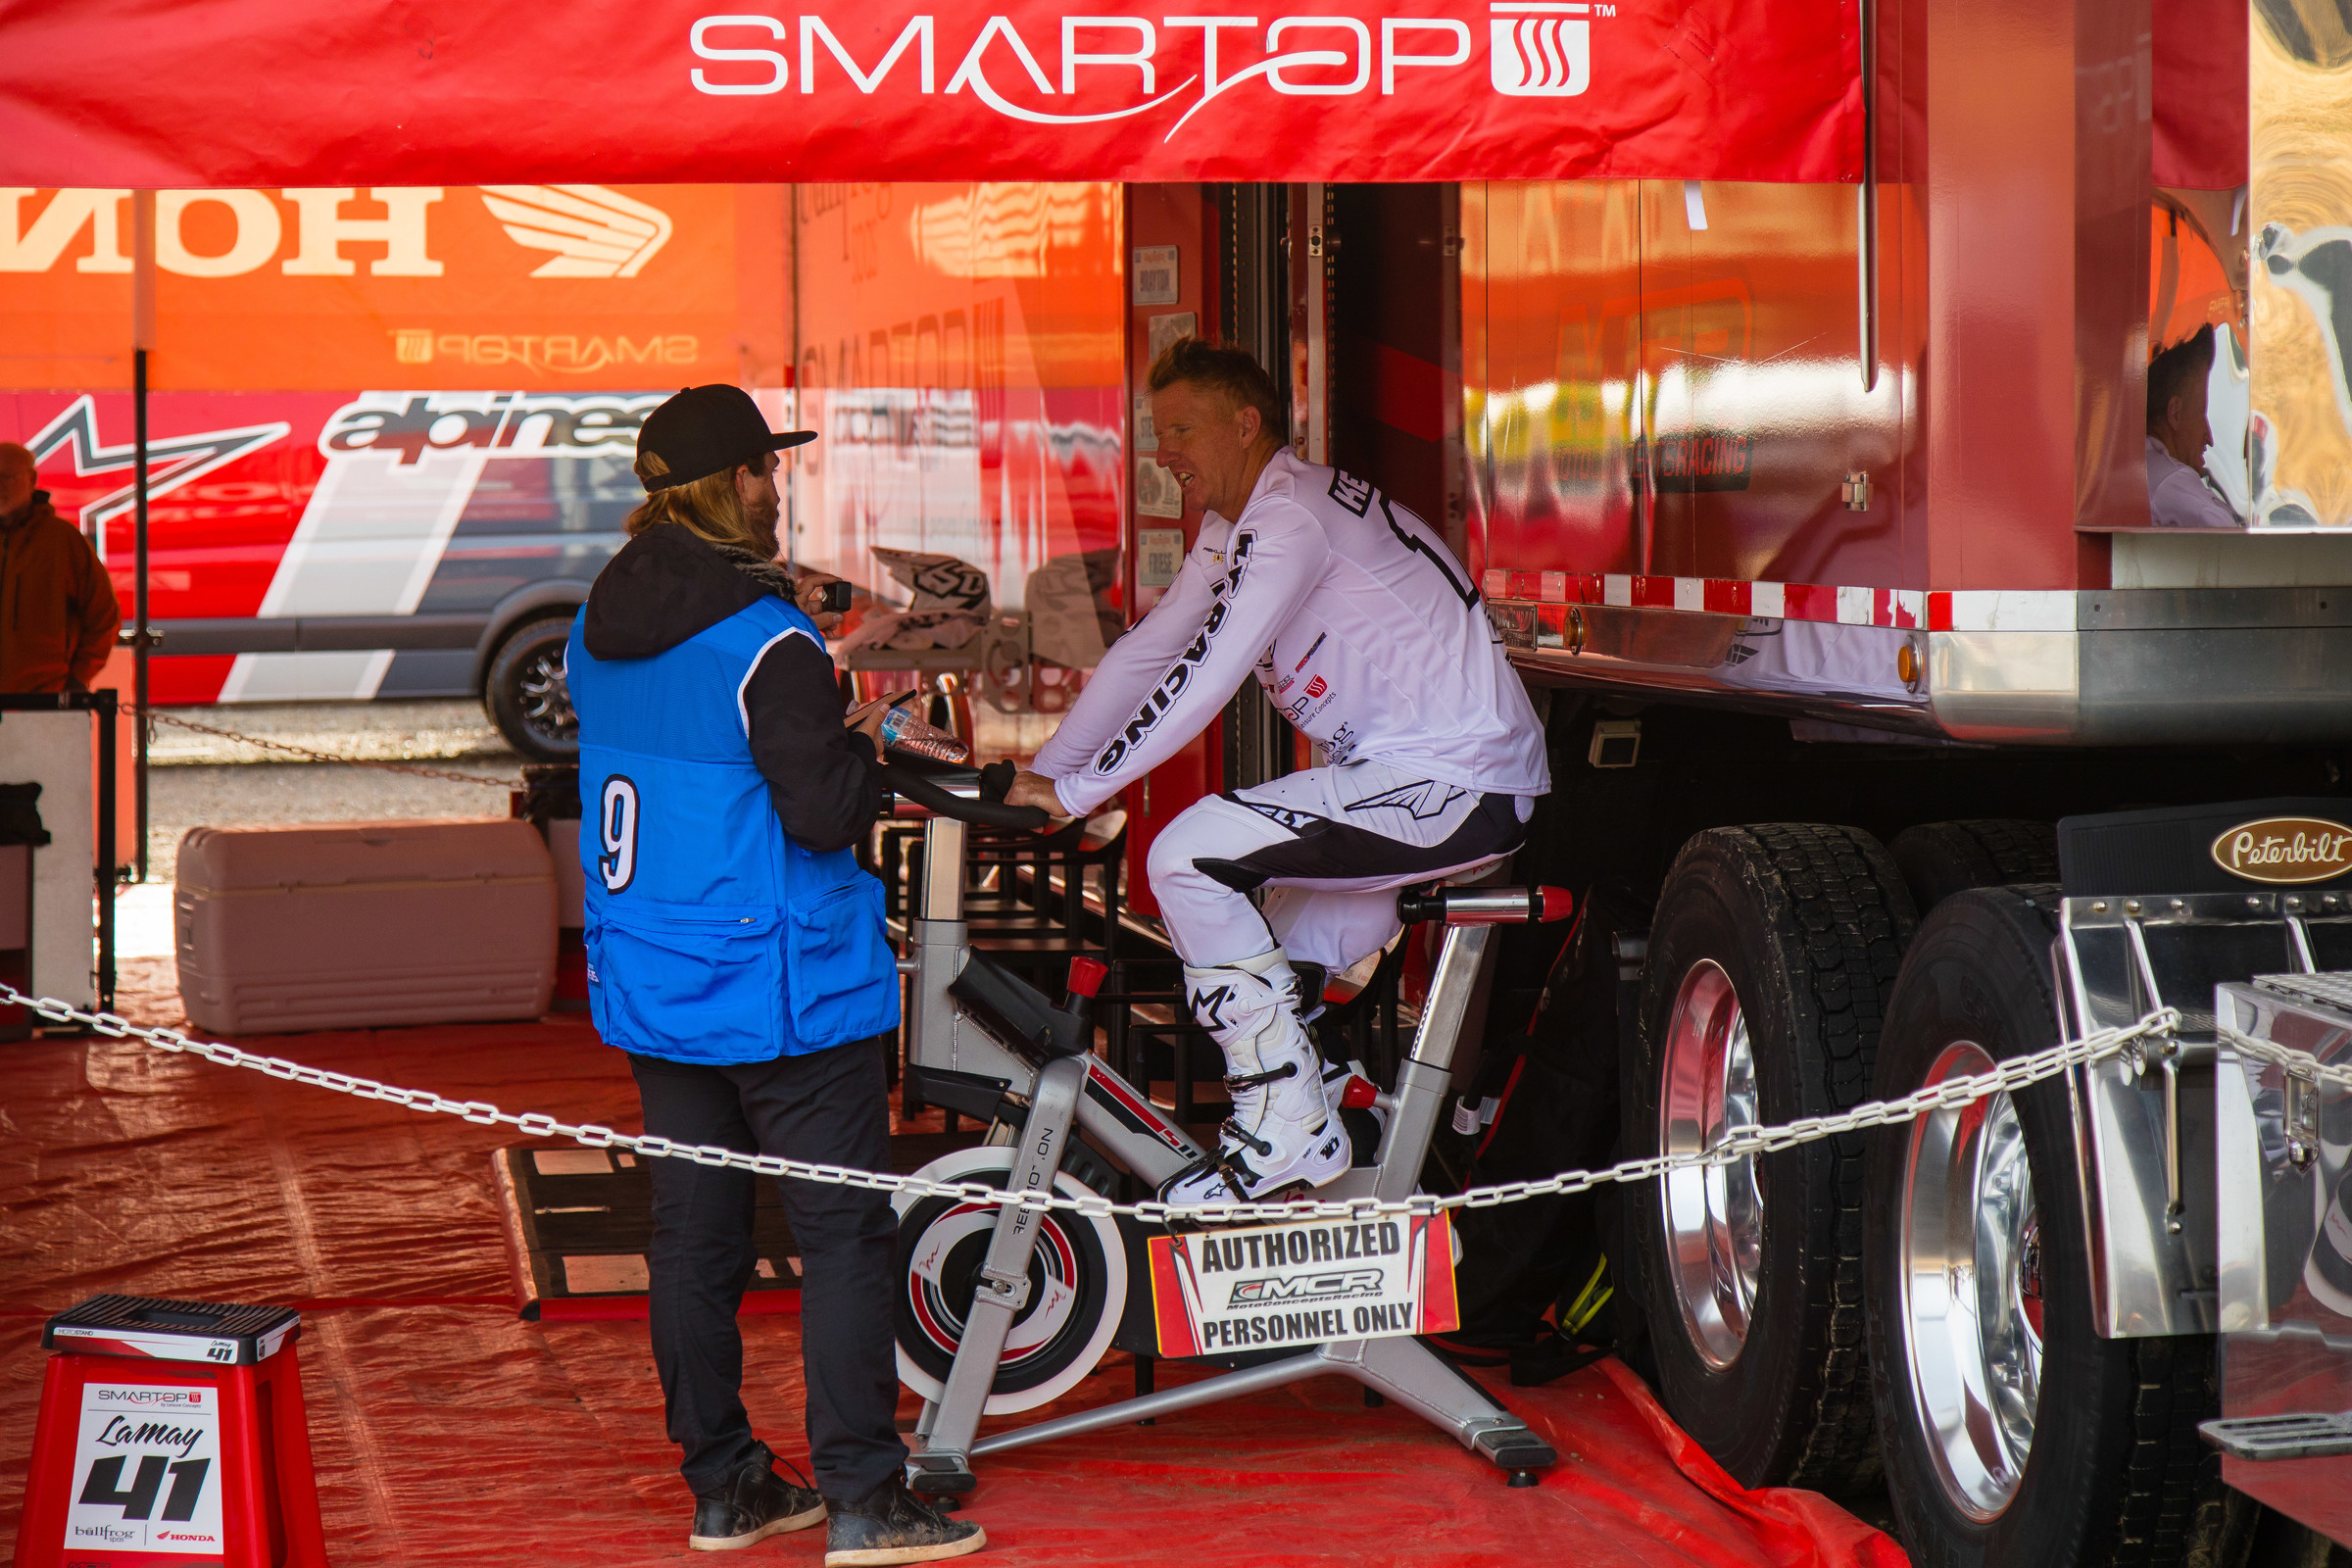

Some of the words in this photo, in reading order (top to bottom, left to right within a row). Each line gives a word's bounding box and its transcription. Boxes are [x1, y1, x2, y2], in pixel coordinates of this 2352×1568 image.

[690, 15, 1470, 143] SMARTOP
[1095, 599, 1230, 775] RACING
[599, 773, 641, 896] 9
[2232, 831, 2352, 869] Peterbilt
[1202, 1221, 1401, 1274] AUTHORIZED
[1258, 1268, 1384, 1299] MCR
[1202, 1308, 1348, 1349] PERSONNEL
[1353, 1302, 1413, 1334] ONLY
[206, 1348, 233, 1362] 41
[98, 1390, 187, 1408] SMARTOP
[95, 1414, 204, 1459] Lamay
[77, 1454, 212, 1522] 41
[170, 1534, 216, 1543] HONDA
